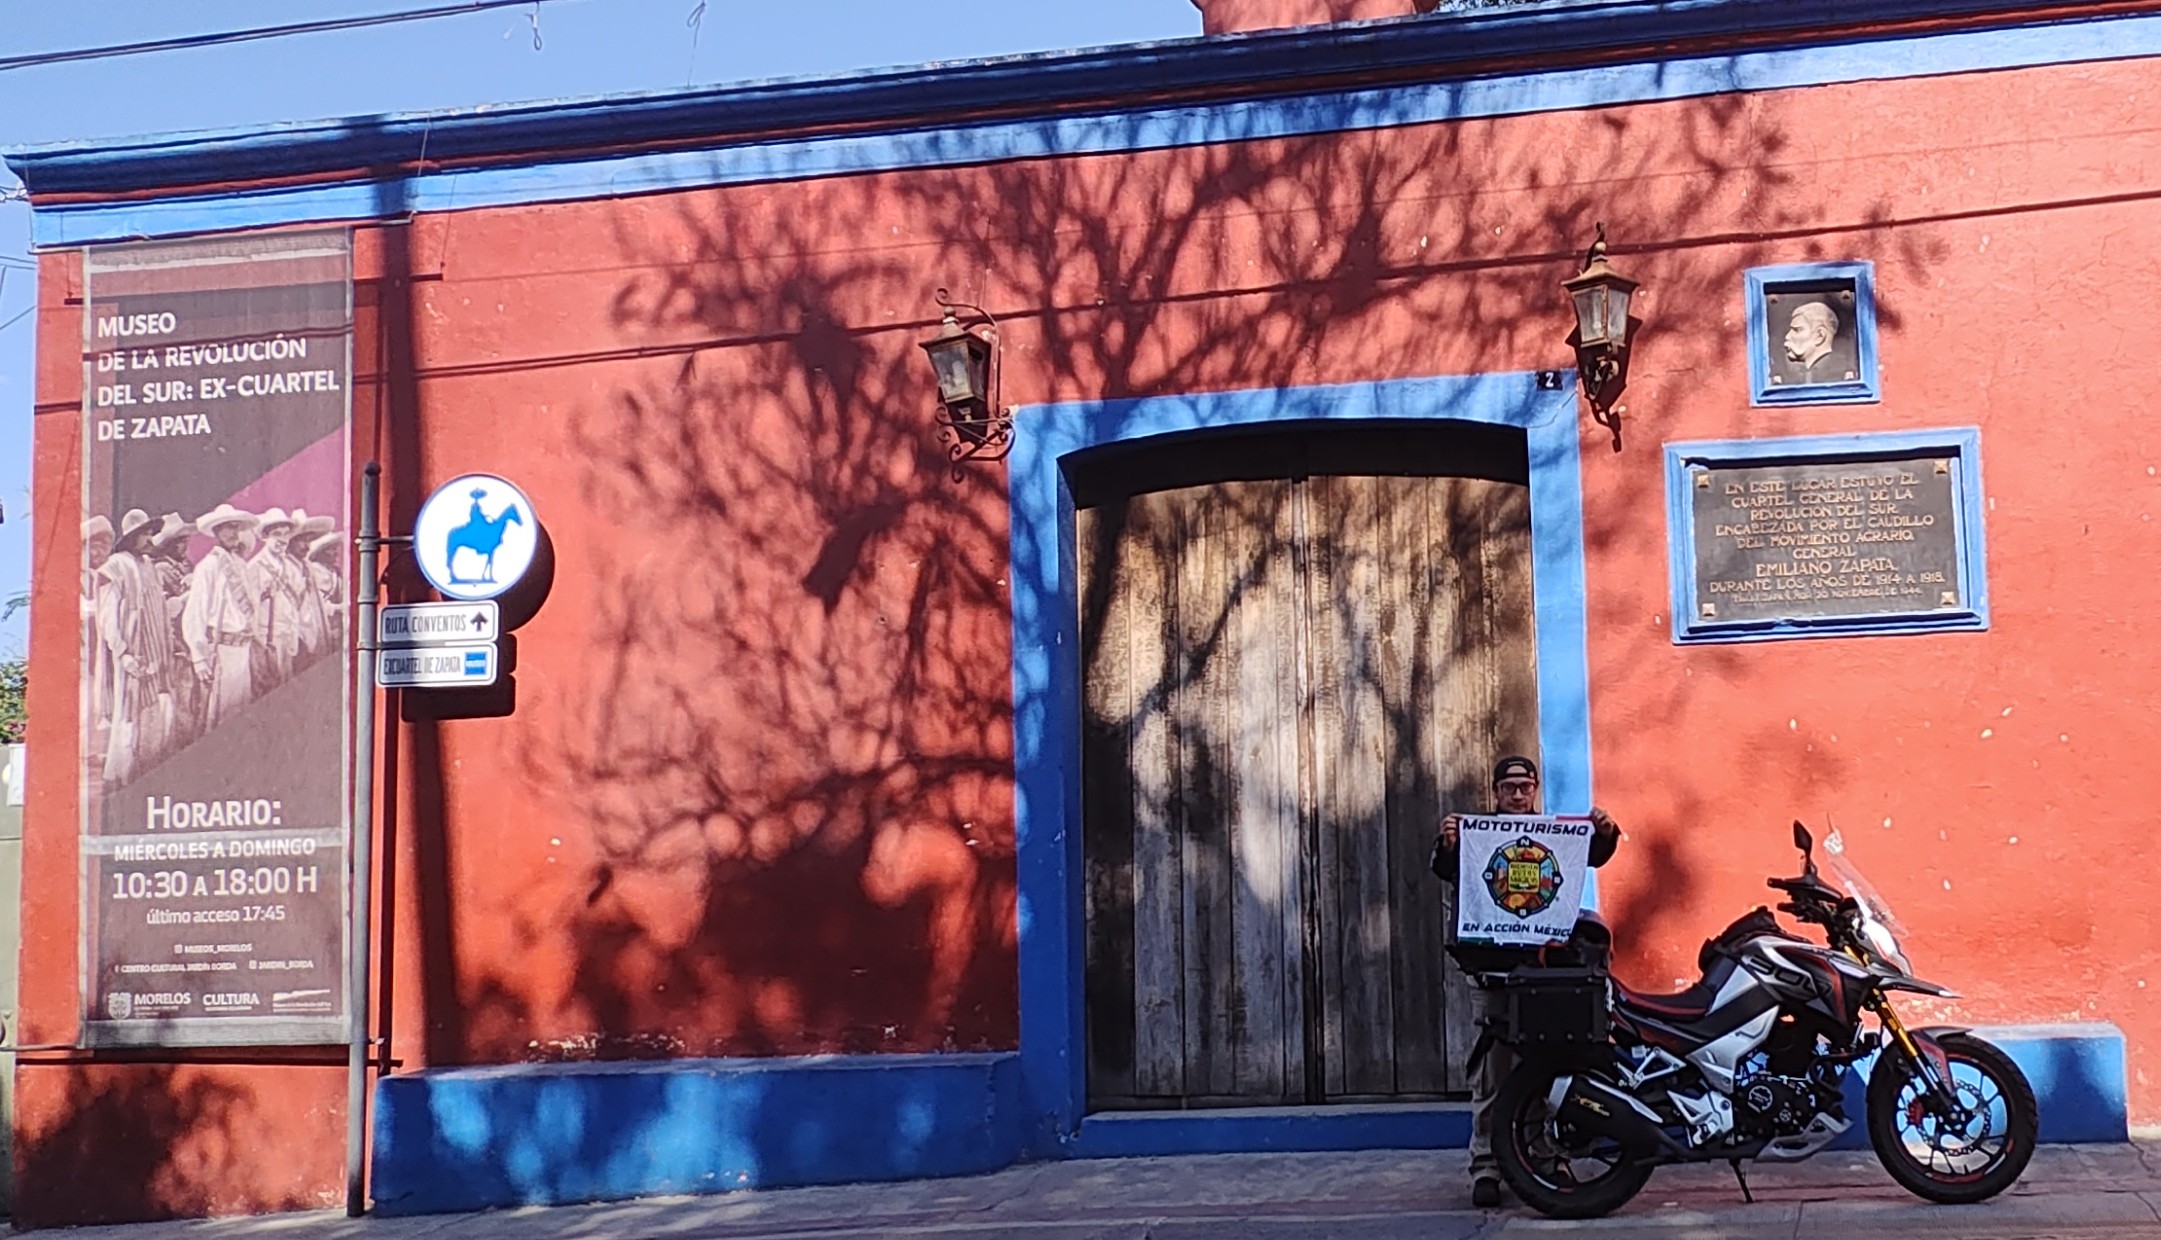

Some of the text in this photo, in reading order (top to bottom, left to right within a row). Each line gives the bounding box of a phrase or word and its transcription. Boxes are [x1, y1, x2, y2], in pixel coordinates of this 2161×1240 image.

[98, 312, 176, 338] MUSEO
[98, 333, 306, 372] DE LA REVOLUCIÓN
[98, 370, 340, 406] DEL SUR: EX-CUARTEL
[1545, 372, 1554, 388] 2
[98, 414, 211, 441] DE ZAPATA
[1726, 473, 1919, 494] EN ESTE LUGAR ESTUVO EL
[1732, 489, 1914, 508] CUARTEL GENERAL DE LA
[1837, 505, 1864, 516] DEL
[1716, 515, 1934, 536] ENCABEZADA POR EL CAUDILLO
[1737, 538, 1765, 548] DEL
[1770, 532, 1850, 546] MOVIMIENTO
[1793, 546, 1857, 559] GENERAL
[1756, 561, 1832, 577] EMILIANO
[1710, 580, 1772, 593] DURANTE
[1776, 579, 1806, 590] LOS
[1811, 574, 1847, 587] AÑOS
[1853, 575, 1871, 586] DE
[1906, 574, 1915, 584] A
[385, 614, 467, 634] RUTA CONVENTOS
[424, 657, 433, 674] DE
[435, 656, 461, 673] ZAPATA
[1463, 819, 1589, 836] MOTOTURISMO
[114, 838, 315, 861] MIÉRCOLES A DOMINGO
[1520, 838, 1530, 846] N
[112, 866, 318, 899] 10:30 A 18:00 H
[147, 905, 285, 924] último acceso 17:45
[1462, 921, 1571, 937] EN ACCIÓN MÉXIC
[151, 964, 186, 972] CULTURAL
[134, 992, 191, 1005] MORELOS
[203, 993, 260, 1005] CULTURA
